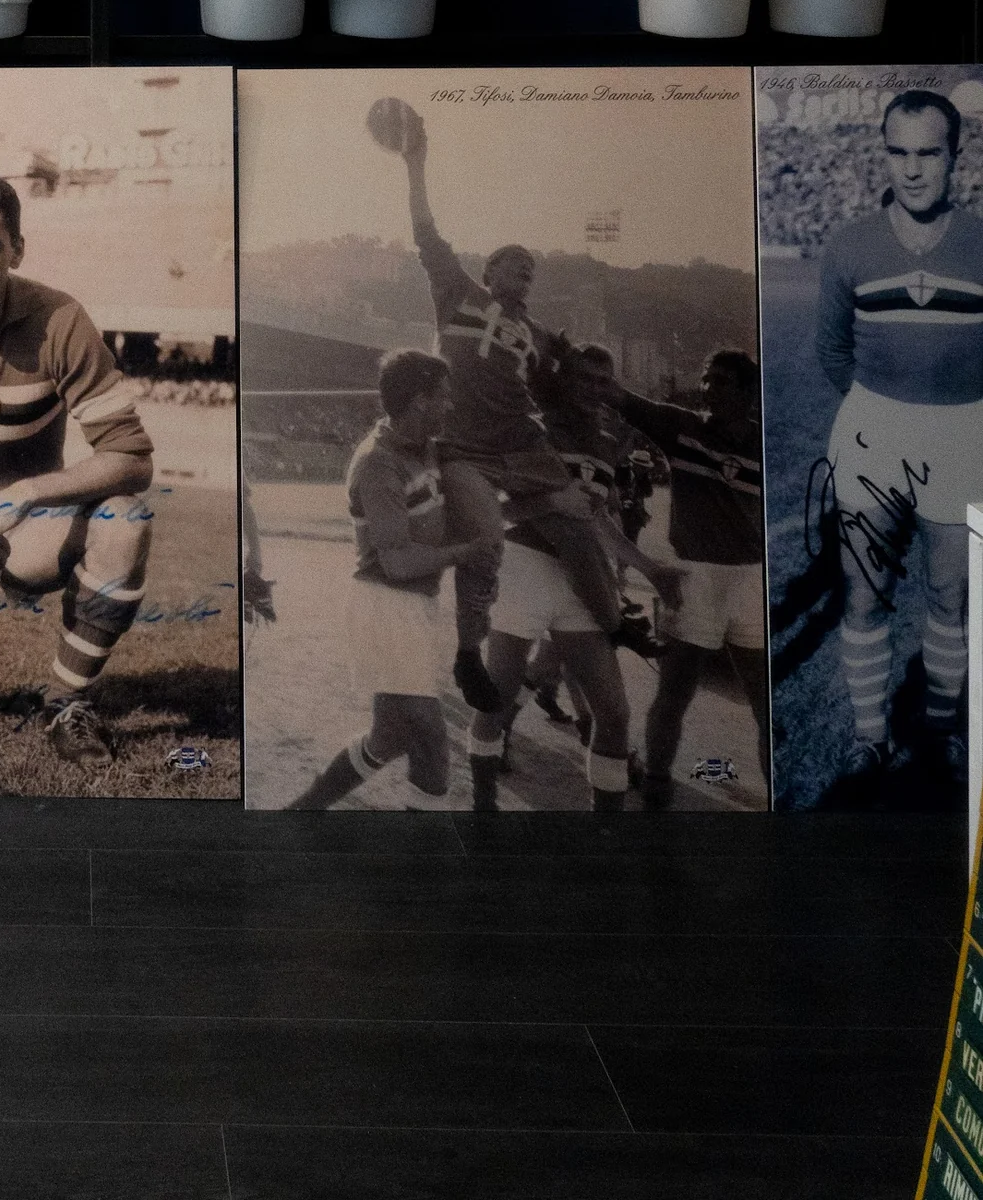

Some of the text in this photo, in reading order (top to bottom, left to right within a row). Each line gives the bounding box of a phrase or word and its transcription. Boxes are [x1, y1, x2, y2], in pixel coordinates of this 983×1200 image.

[800, 73, 865, 90] Baldini
[865, 79, 873, 89] e
[876, 72, 943, 90] Bassetto
[429, 88, 466, 104] 1967,
[469, 85, 516, 107] Tifosi,
[519, 85, 589, 102] Damiano
[660, 84, 741, 102] Tamburino
